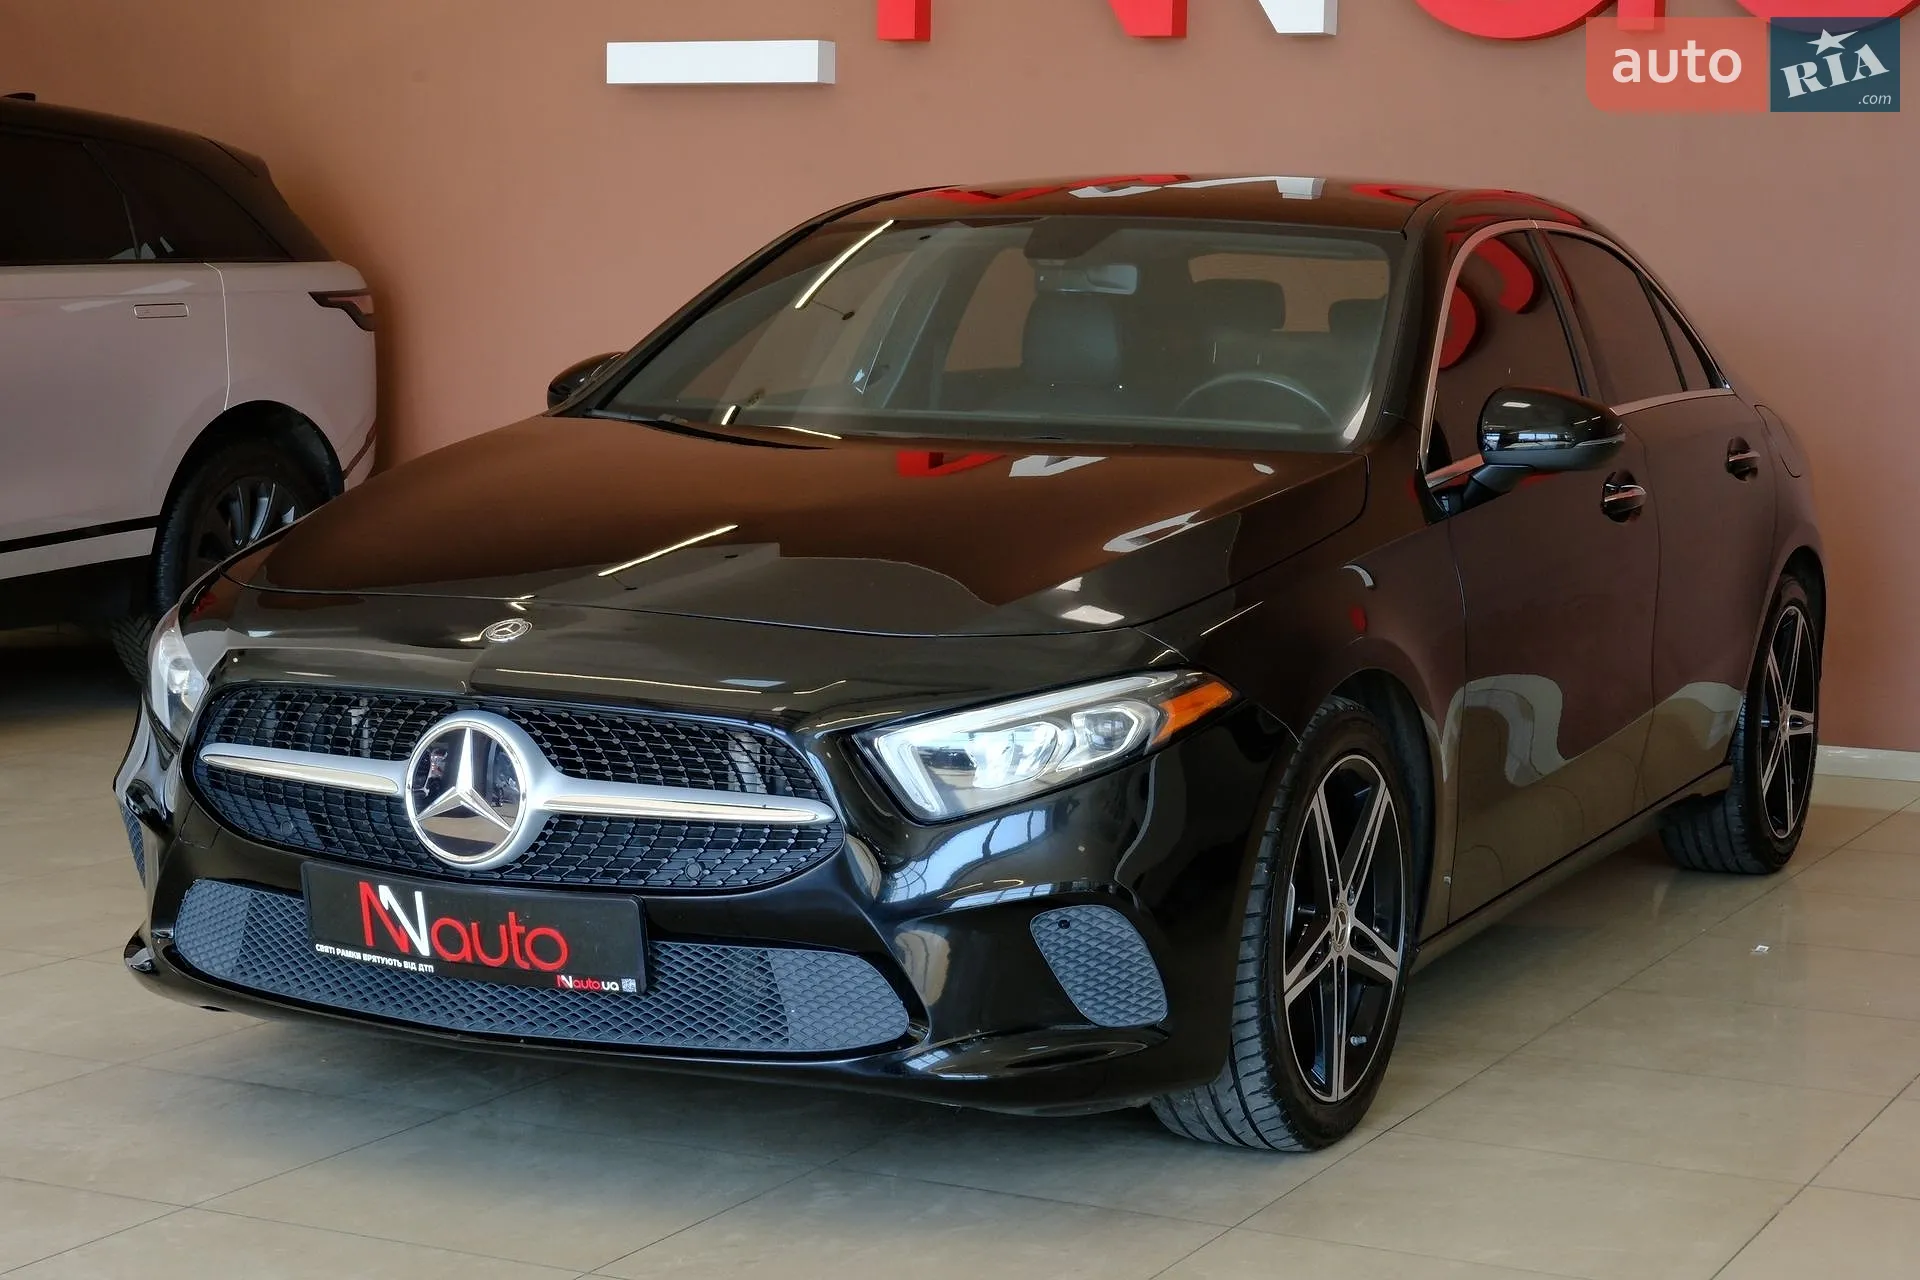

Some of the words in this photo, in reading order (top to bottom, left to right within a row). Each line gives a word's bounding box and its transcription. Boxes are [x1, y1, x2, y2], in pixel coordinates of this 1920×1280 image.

[363, 953, 402, 967] ВРЯТУЮТЬ
[403, 960, 417, 971] ВІД
[418, 963, 434, 973] ДТП
